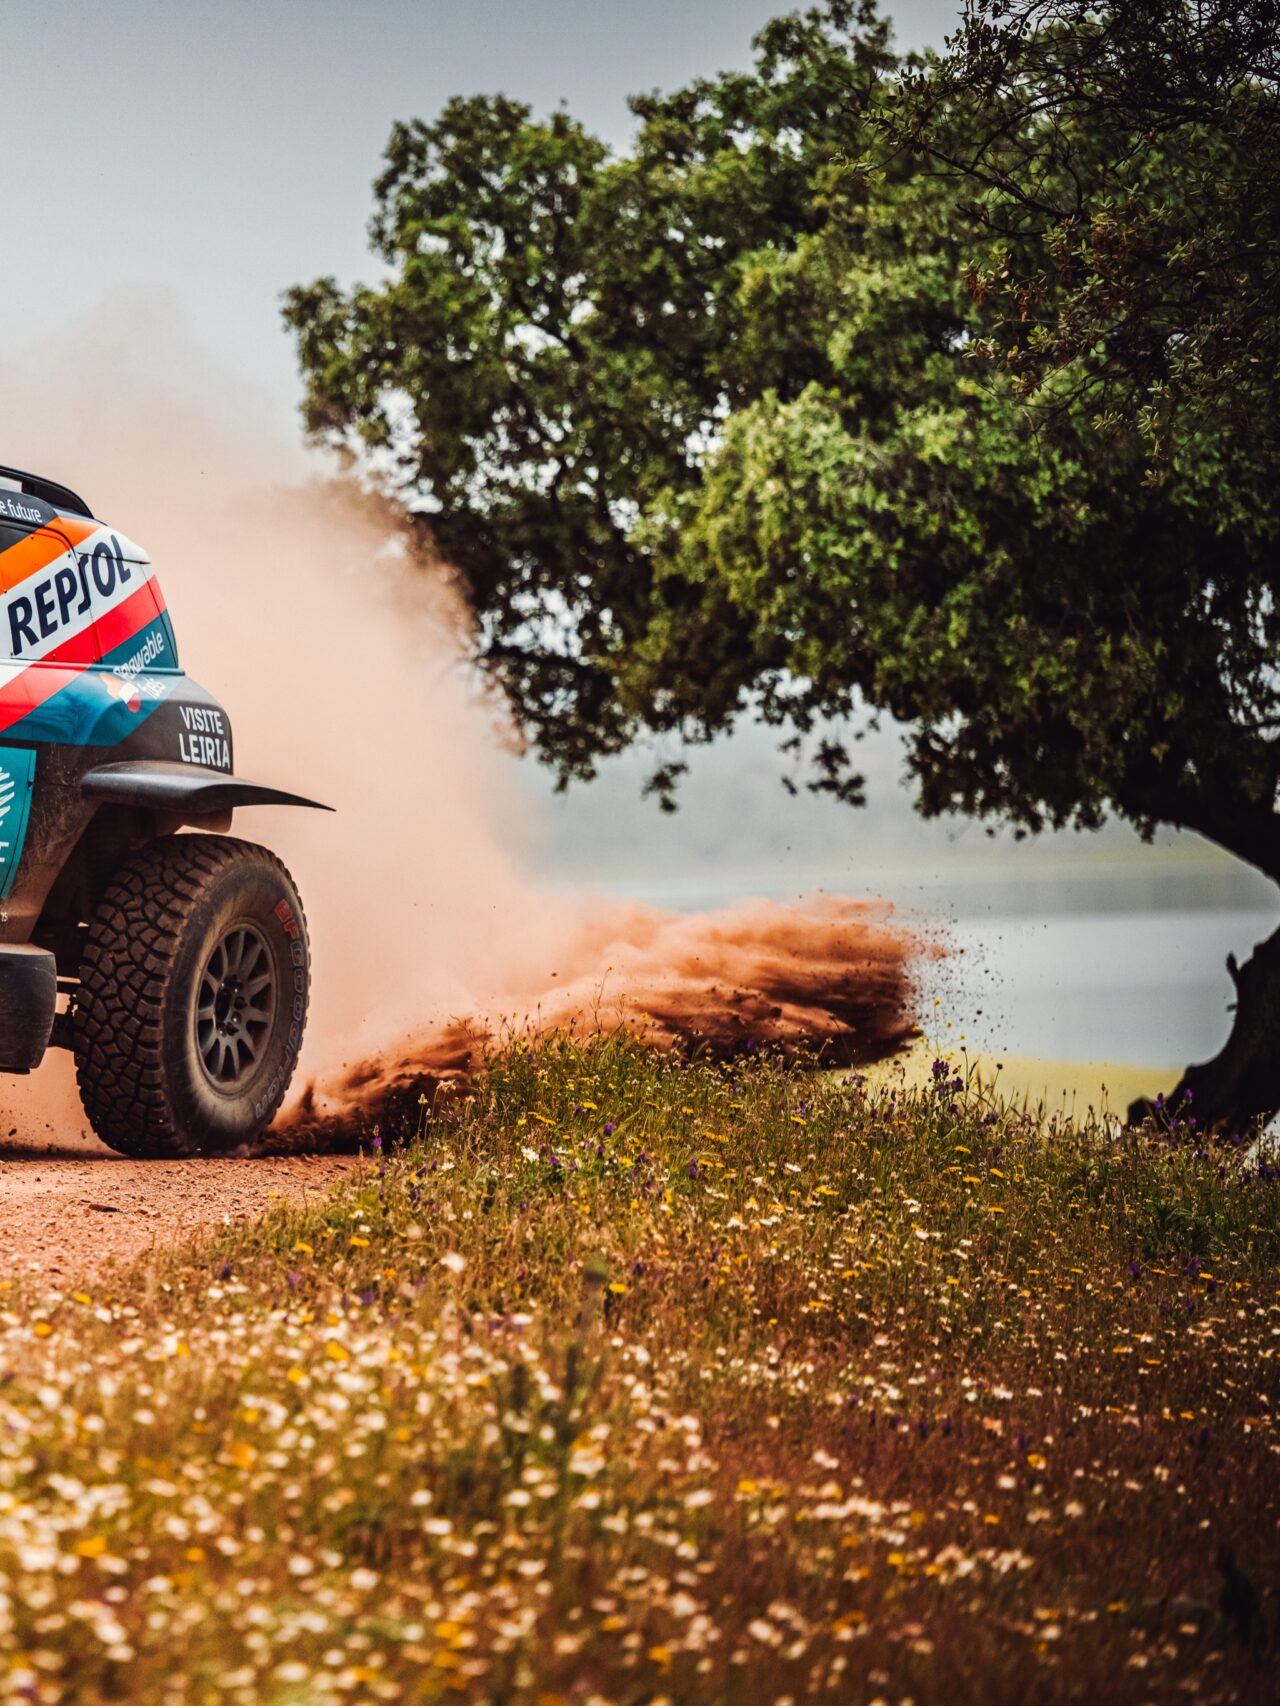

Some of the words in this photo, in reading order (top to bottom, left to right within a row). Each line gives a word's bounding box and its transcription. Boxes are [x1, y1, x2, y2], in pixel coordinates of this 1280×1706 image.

[7, 498, 43, 523] future
[7, 534, 131, 656] REPSOL
[179, 705, 224, 735] VISITE
[178, 733, 231, 769] LEIRIA
